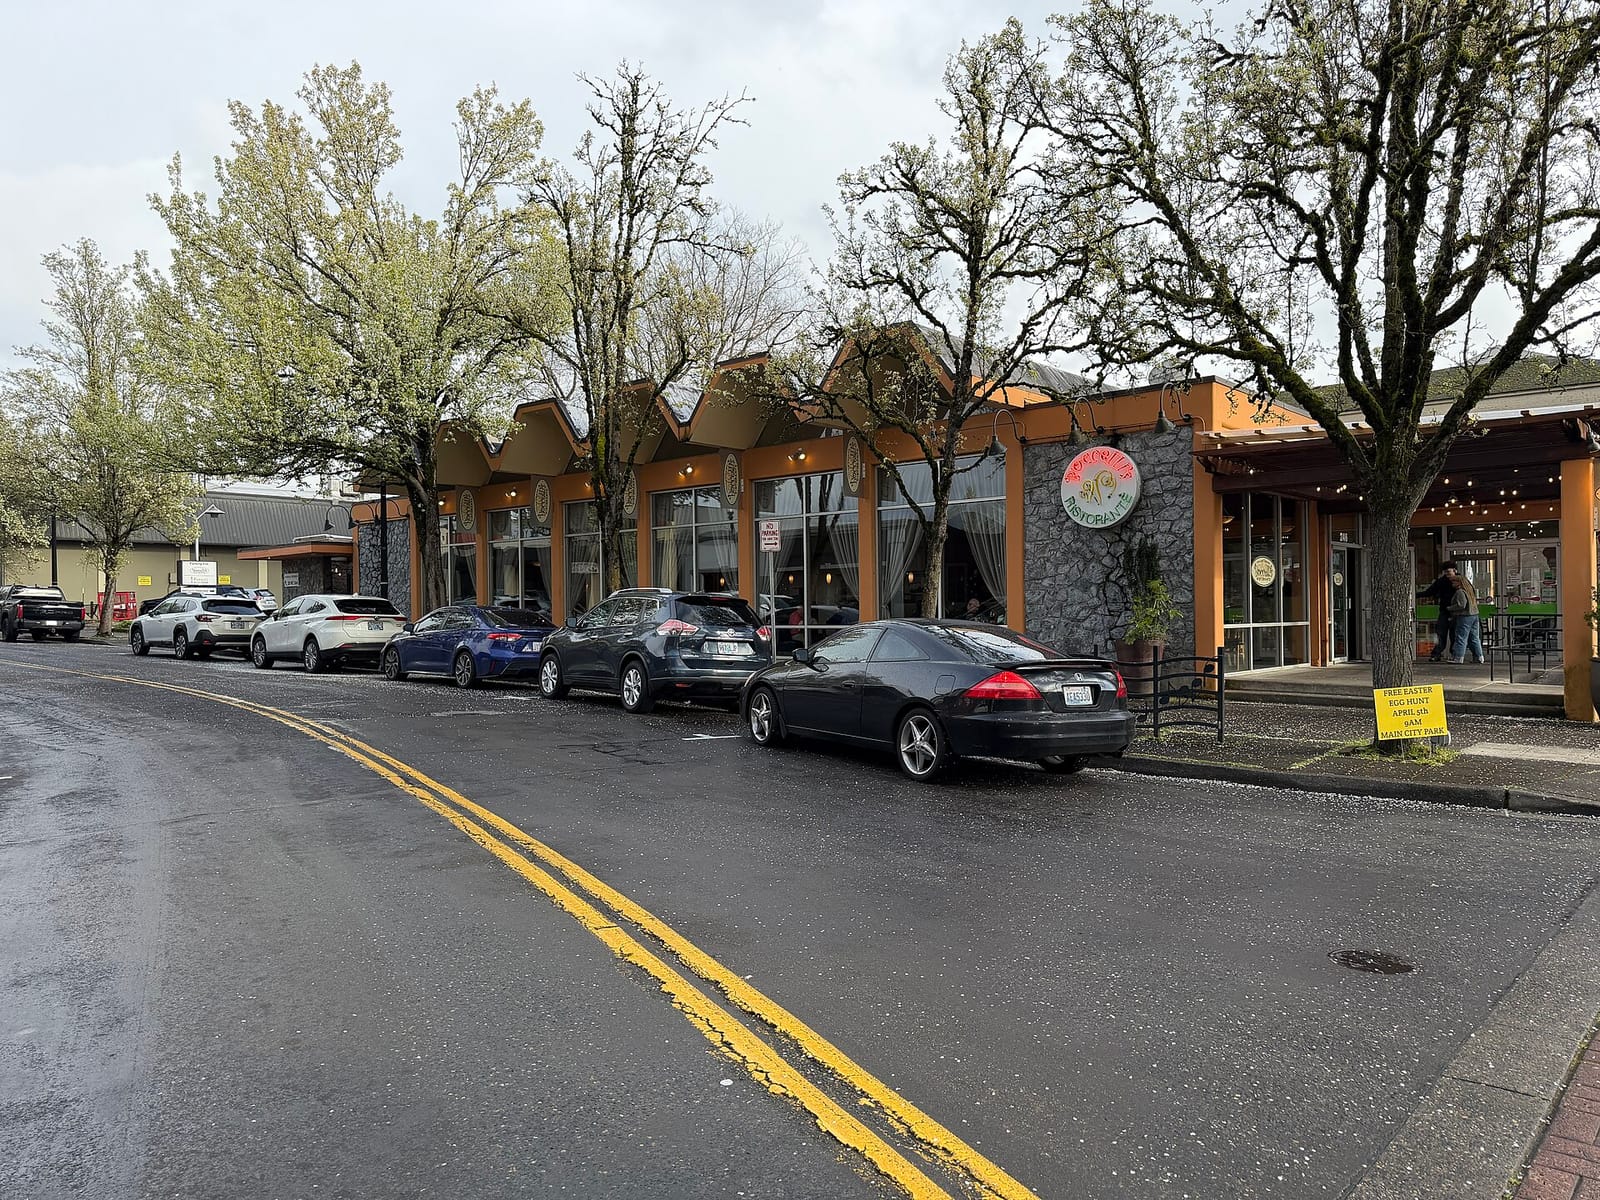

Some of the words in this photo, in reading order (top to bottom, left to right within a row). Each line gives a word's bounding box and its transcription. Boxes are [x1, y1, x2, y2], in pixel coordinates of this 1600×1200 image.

[1064, 492, 1133, 525] RISTORANTE
[1489, 530, 1517, 541] 234
[1383, 688, 1403, 697] FREE
[1404, 686, 1433, 695] EASTER
[1389, 699, 1405, 707] EGG
[1406, 697, 1430, 706] HUNT
[1392, 708, 1415, 717] APRIL
[1416, 707, 1429, 715] 5th
[1404, 719, 1422, 727] 9AM
[1380, 730, 1403, 739] MAIN
[1404, 729, 1422, 737] CITY
[1424, 727, 1445, 735] PARK
